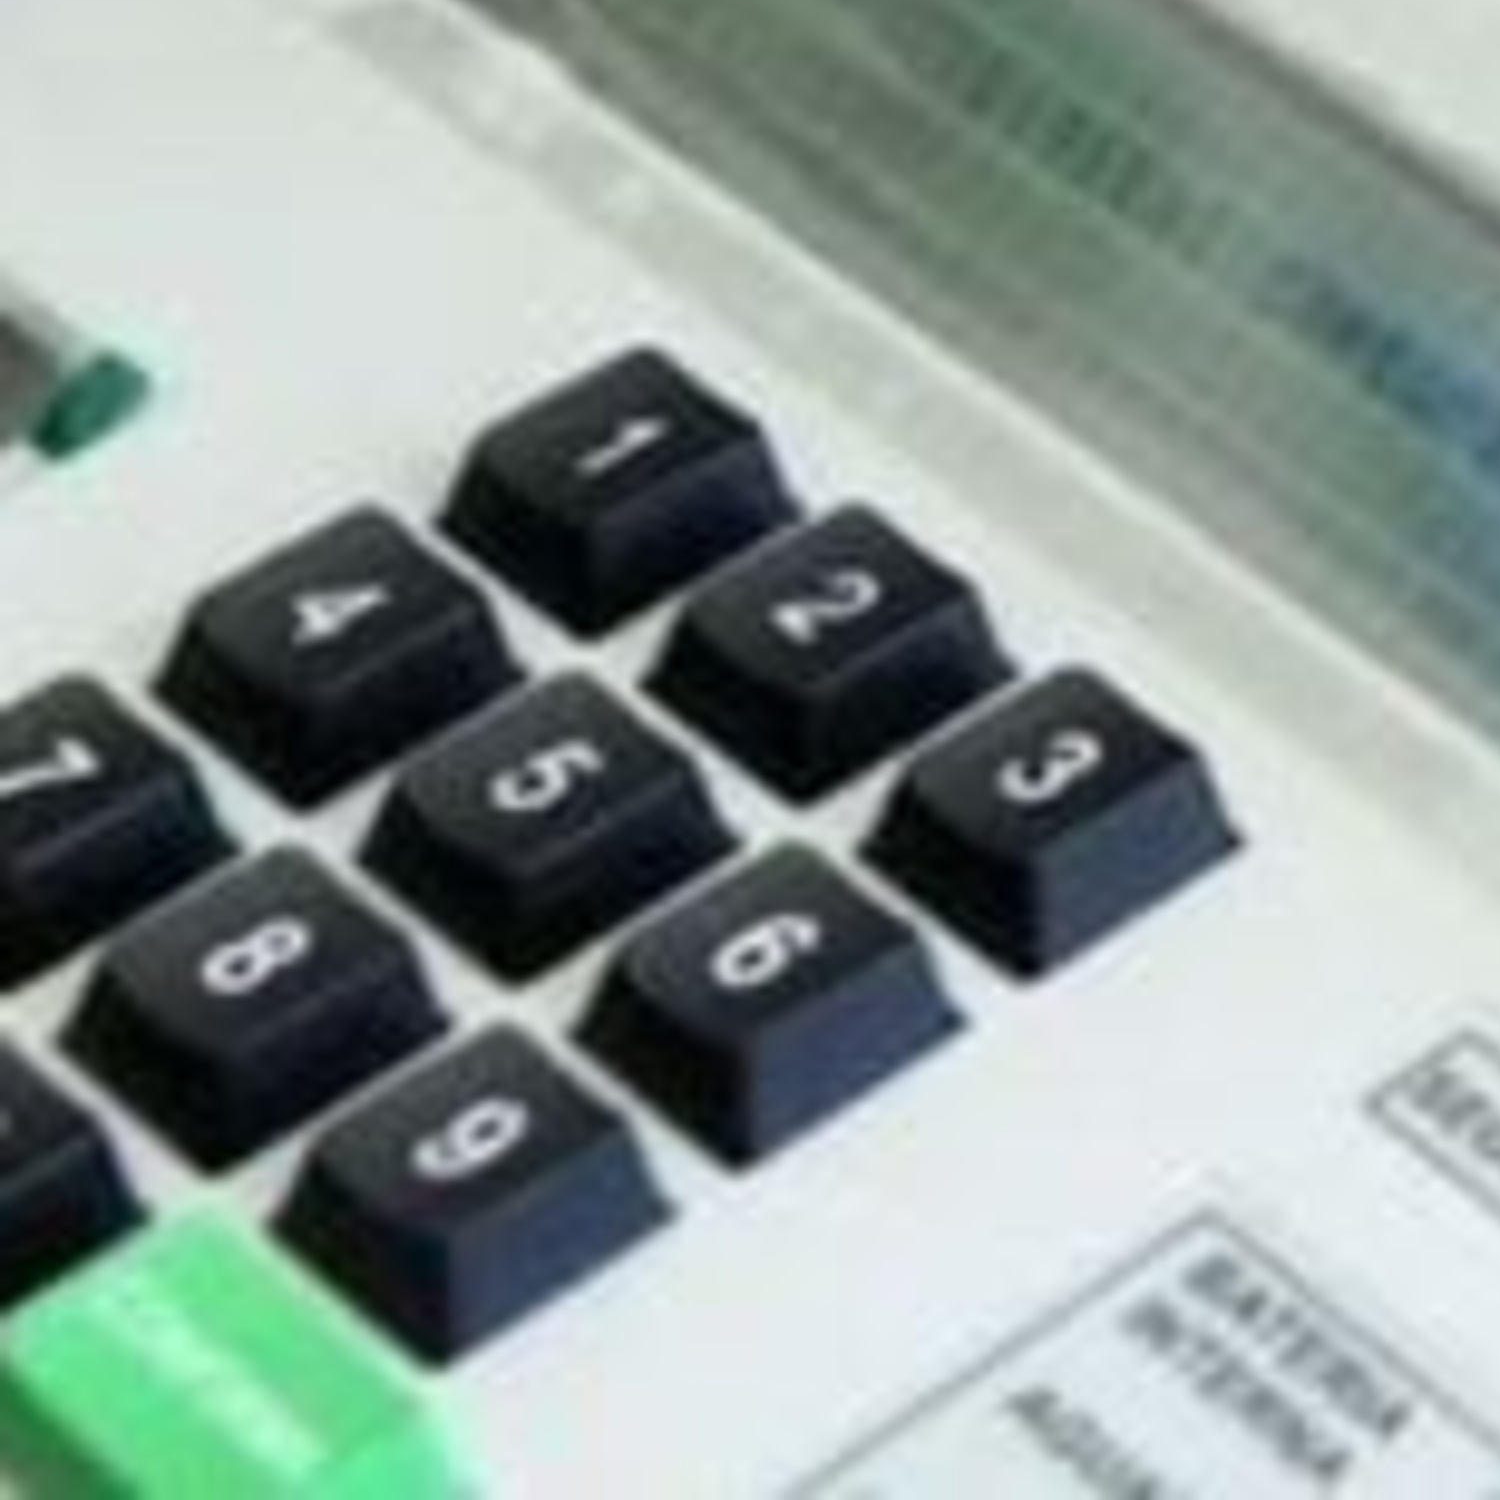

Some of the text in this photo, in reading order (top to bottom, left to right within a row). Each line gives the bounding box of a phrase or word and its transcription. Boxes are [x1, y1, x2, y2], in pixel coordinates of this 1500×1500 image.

[577, 418, 667, 475] 1
[292, 584, 383, 645] 4
[771, 571, 882, 644] 2
[0, 737, 100, 794] 7
[491, 739, 601, 812] 5
[999, 730, 1100, 802] 3
[202, 917, 312, 993] 8
[710, 913, 819, 987] 6
[411, 1098, 528, 1179] 9
